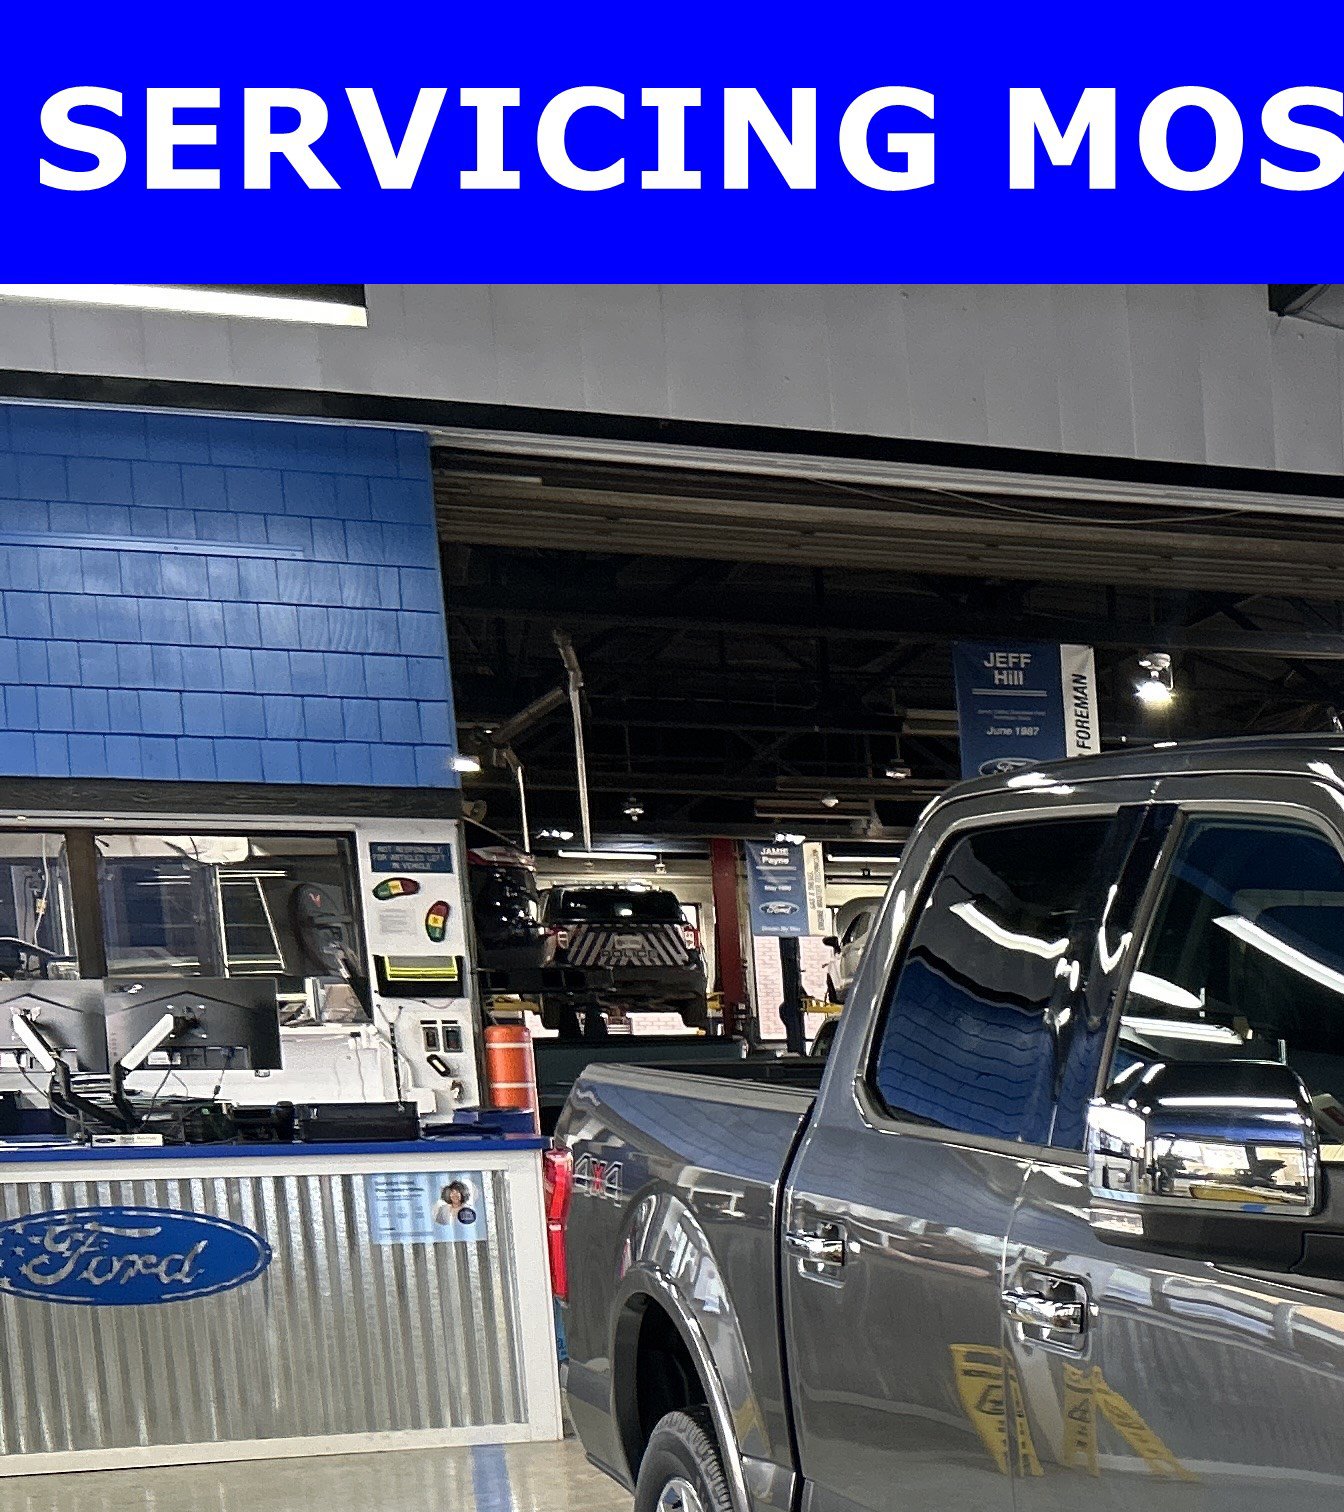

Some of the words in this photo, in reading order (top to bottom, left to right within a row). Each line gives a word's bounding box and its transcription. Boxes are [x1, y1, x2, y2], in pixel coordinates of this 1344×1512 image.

[983, 652, 1032, 668] JEFF
[993, 669, 1024, 685] Hill
[1071, 673, 1092, 750] FOREMAN
[986, 727, 1013, 735] June
[761, 848, 789, 856] JAMIE
[20, 1221, 208, 1286] Ford
